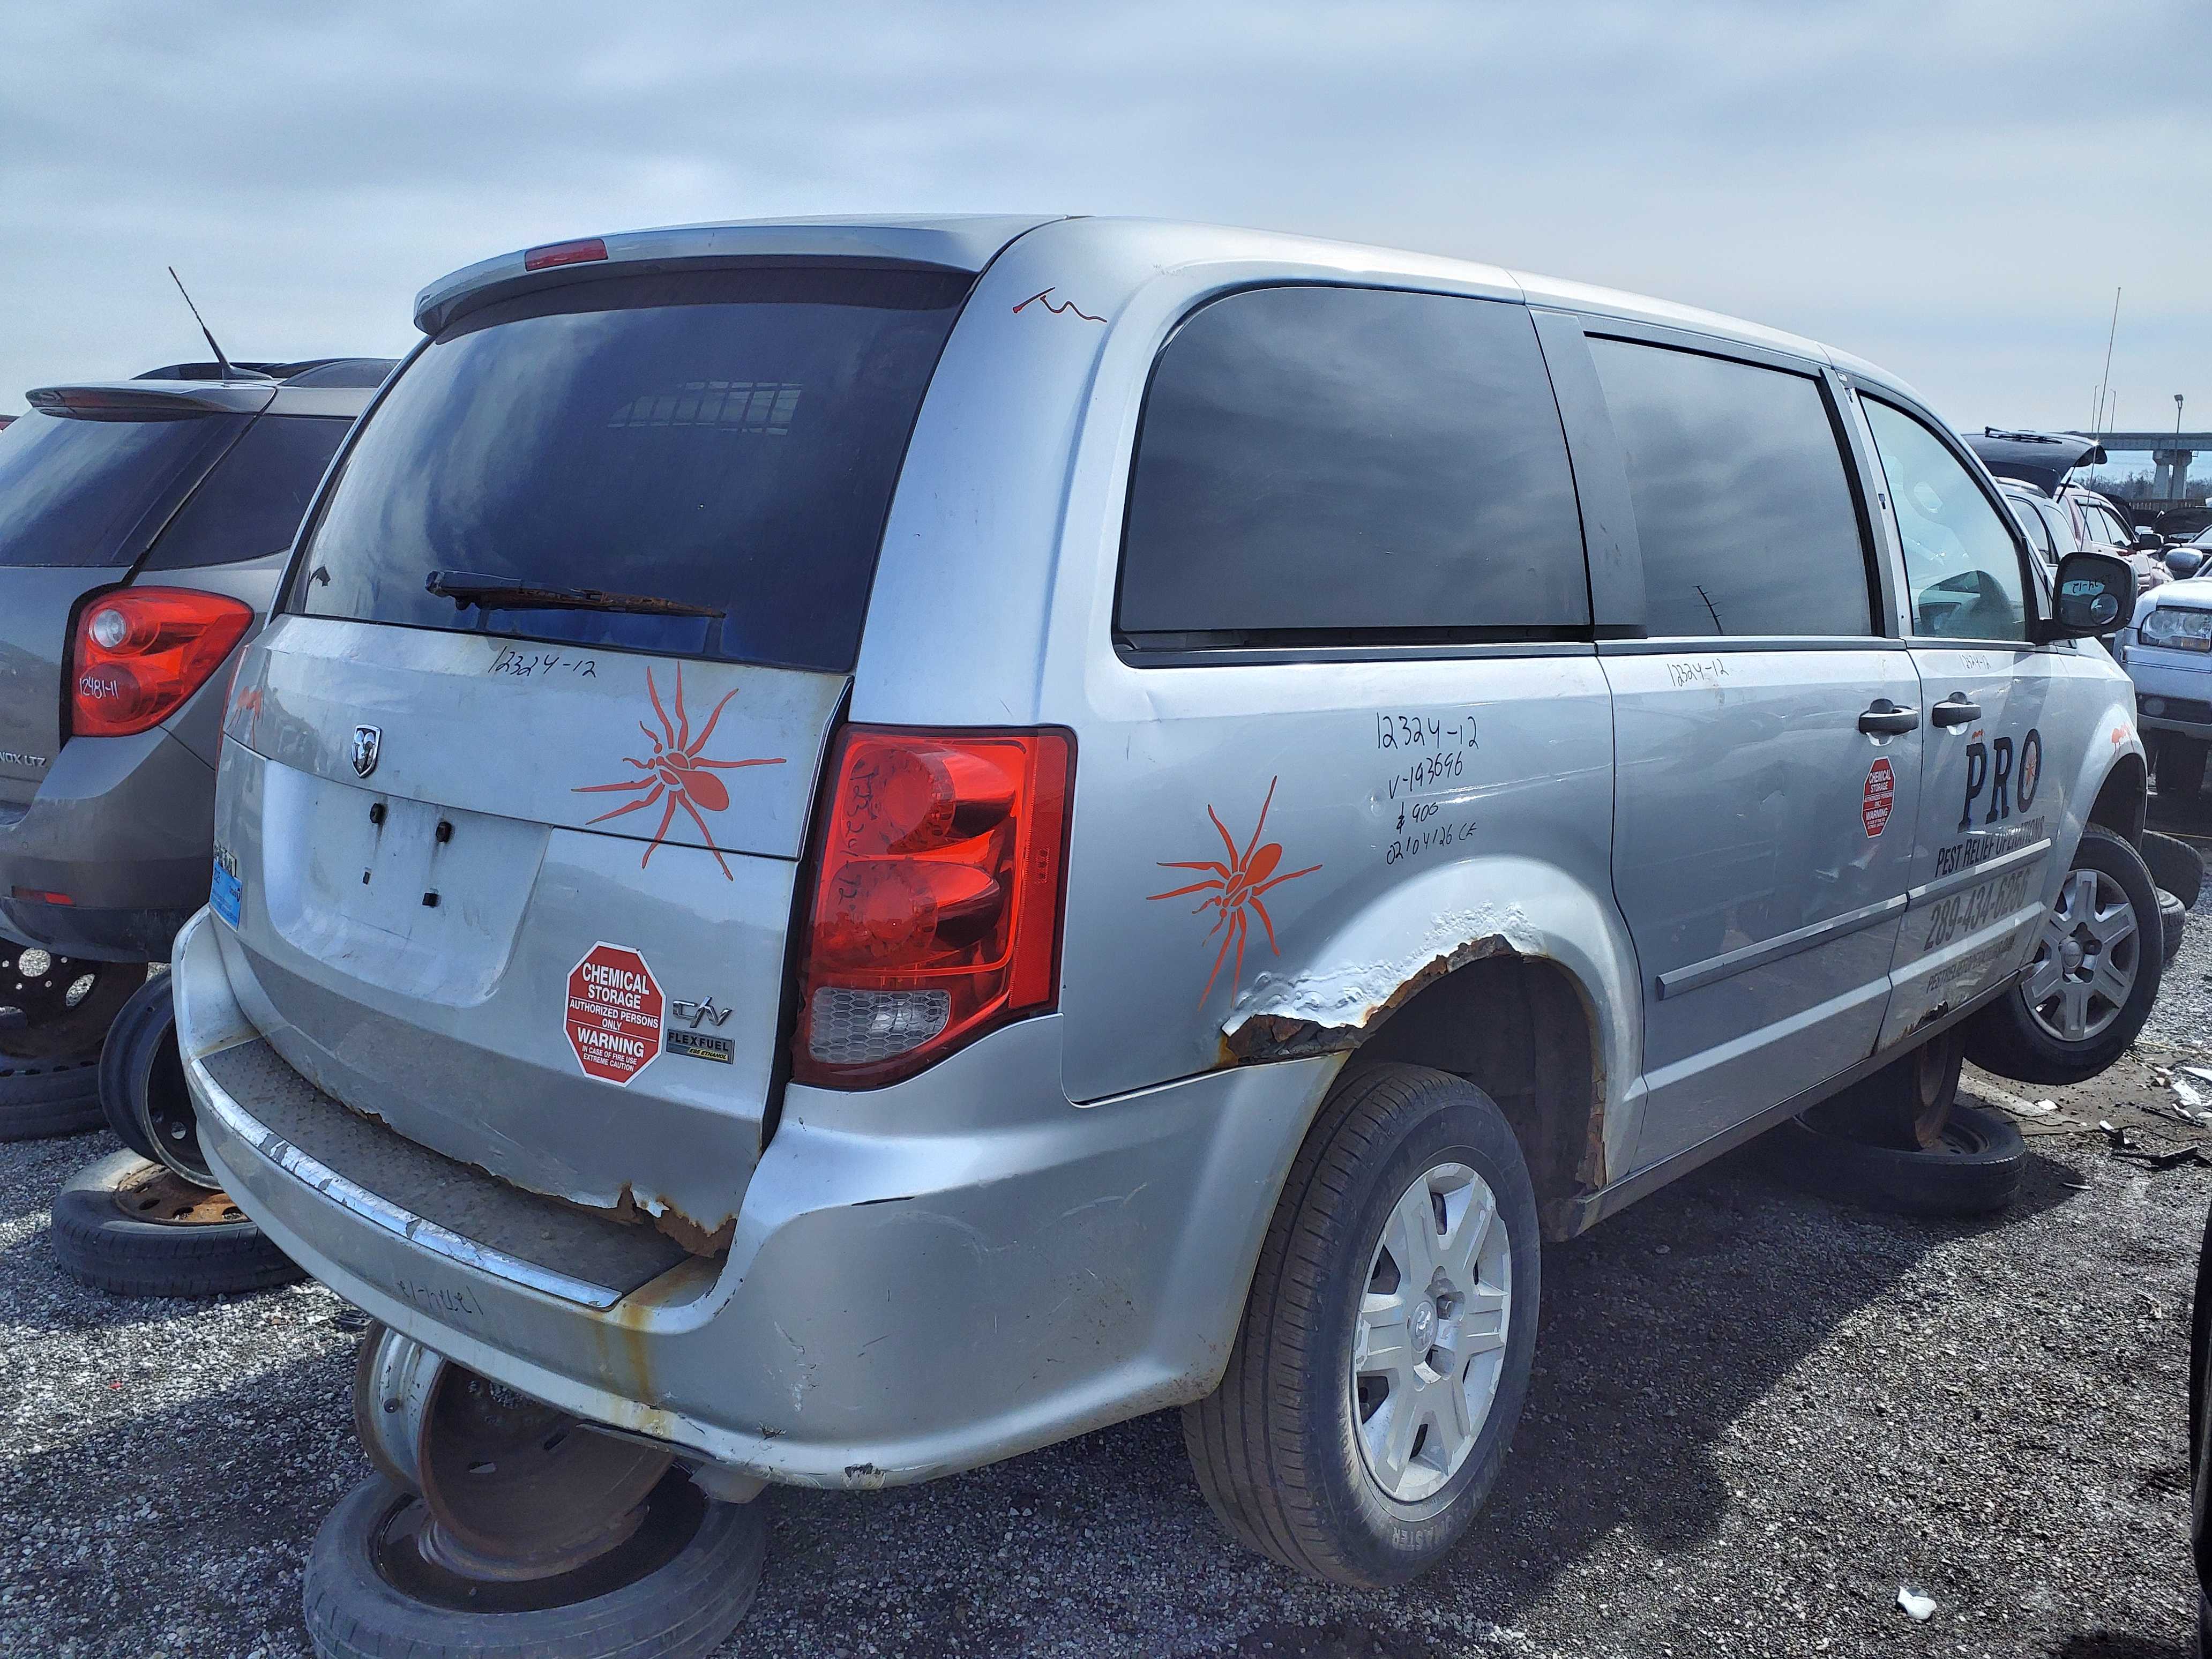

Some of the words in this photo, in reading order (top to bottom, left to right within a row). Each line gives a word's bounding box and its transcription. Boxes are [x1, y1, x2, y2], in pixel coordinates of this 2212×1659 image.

[488, 646, 596, 678] 12324-12
[1667, 658, 1729, 687] 12324-12
[79, 676, 119, 700] 12481-11
[1377, 712, 1479, 749] 12324-12
[24, 755, 47, 767] LTZ
[1869, 769, 1891, 784] CHEMICAL
[1957, 729, 2042, 833] PRO
[1866, 808, 1888, 821] WARNING
[1935, 844, 1963, 878] PEST
[582, 962, 651, 995] CHEMICAL
[588, 984, 641, 1010] STORAGE
[569, 999, 619, 1019] AUTHORIZED
[621, 1012, 659, 1029] PERSONS
[602, 1018, 622, 1031] ONLY
[577, 1027, 645, 1058] WARNING
[668, 1032, 729, 1052] FLEXFUEL
[583, 1053, 609, 1066] EXTREME
[609, 1059, 634, 1072] CAUTION
[588, 1047, 603, 1056] CASE
[612, 1053, 625, 1062] FIRE
[626, 1056, 637, 1065] USE
[701, 1051, 727, 1059] ETHANOL
